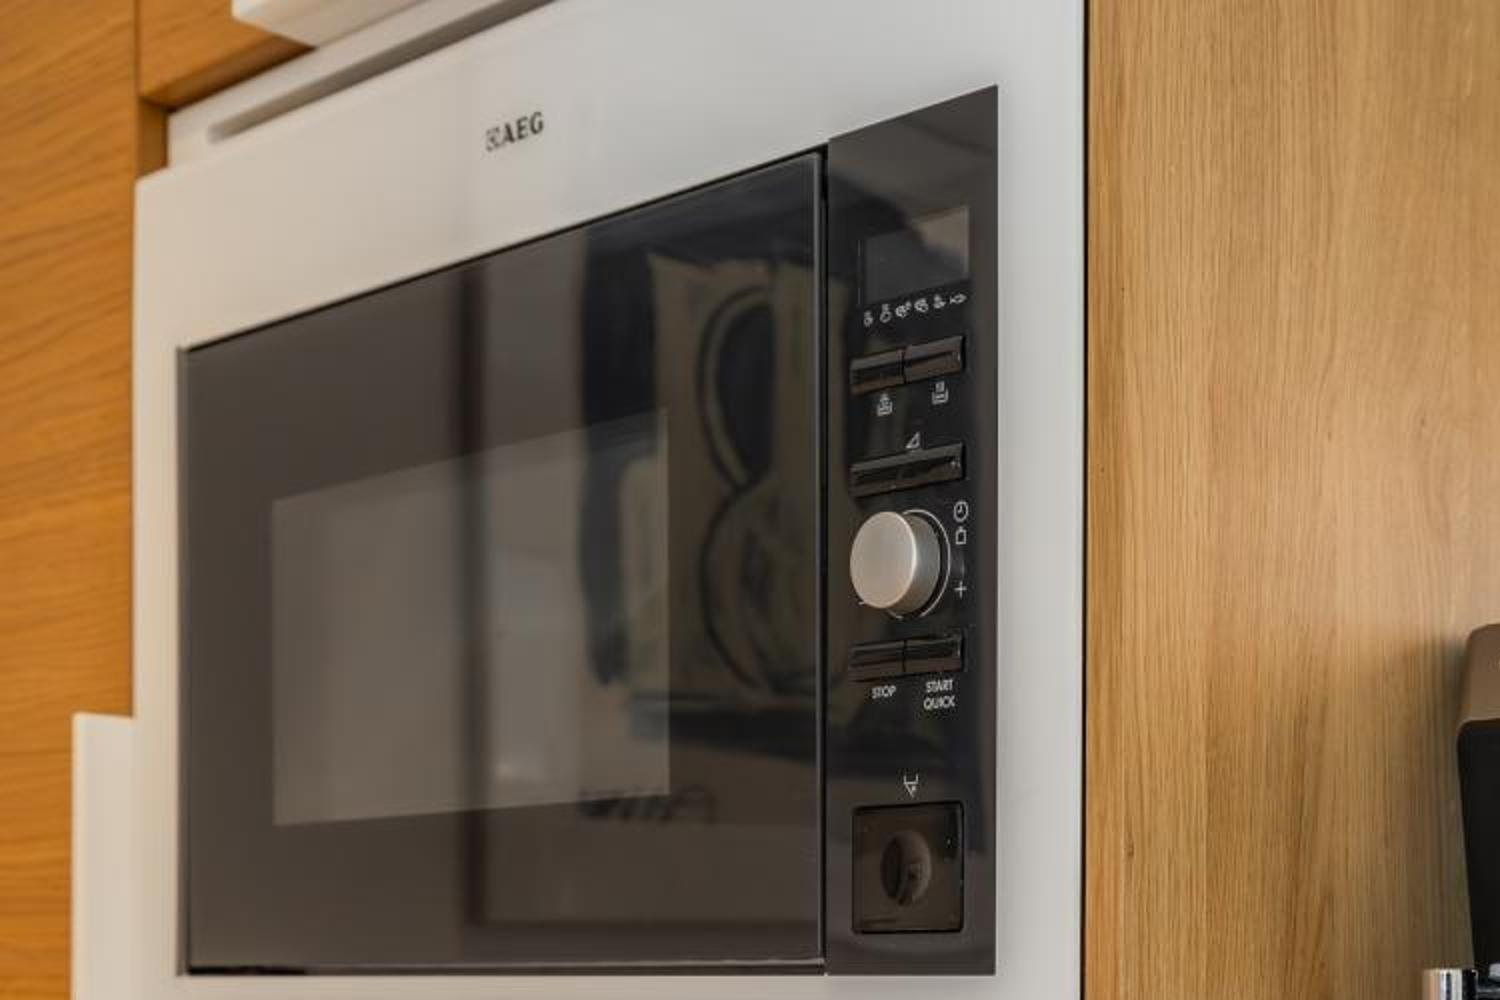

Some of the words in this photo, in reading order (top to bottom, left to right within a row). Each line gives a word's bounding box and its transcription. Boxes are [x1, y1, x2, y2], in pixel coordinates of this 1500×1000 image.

[500, 111, 544, 145] AEG
[872, 685, 896, 699] STOP
[925, 679, 954, 693] START
[923, 695, 956, 710] QUICK
